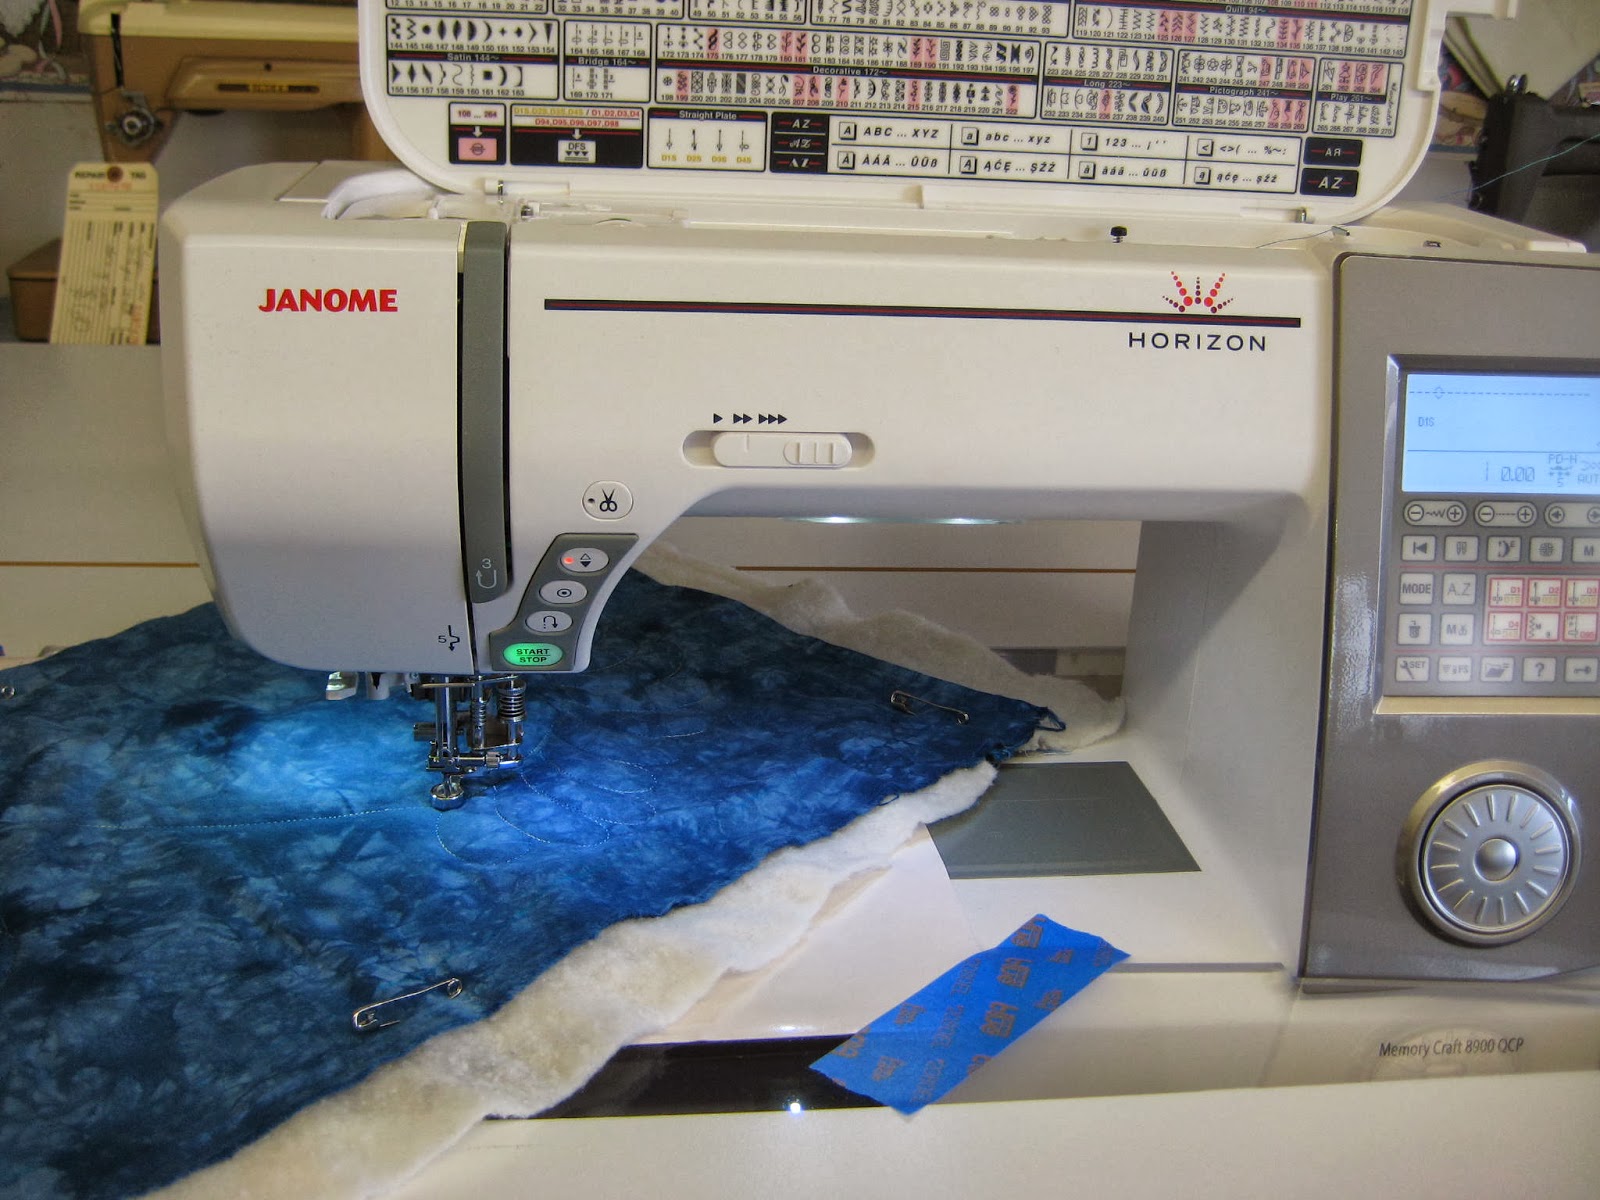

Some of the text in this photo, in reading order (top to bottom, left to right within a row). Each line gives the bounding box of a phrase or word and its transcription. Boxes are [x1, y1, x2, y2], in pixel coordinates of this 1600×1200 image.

[447, 53, 471, 61] Satin
[578, 57, 609, 66] Bridge
[813, 66, 861, 75] Decorative
[1084, 80, 1106, 88] Long
[1209, 86, 1254, 97] Pictograph
[1331, 93, 1348, 102] Play
[679, 110, 713, 120] Straight
[568, 142, 586, 150] DFS
[258, 288, 398, 312] JANOME
[1128, 332, 1266, 351] HORIZON
[482, 558, 491, 569] 3
[1402, 583, 1431, 594] MODE
[438, 635, 447, 643] 5
[1378, 1037, 1524, 1058] Memory Craft 8900 QCP
